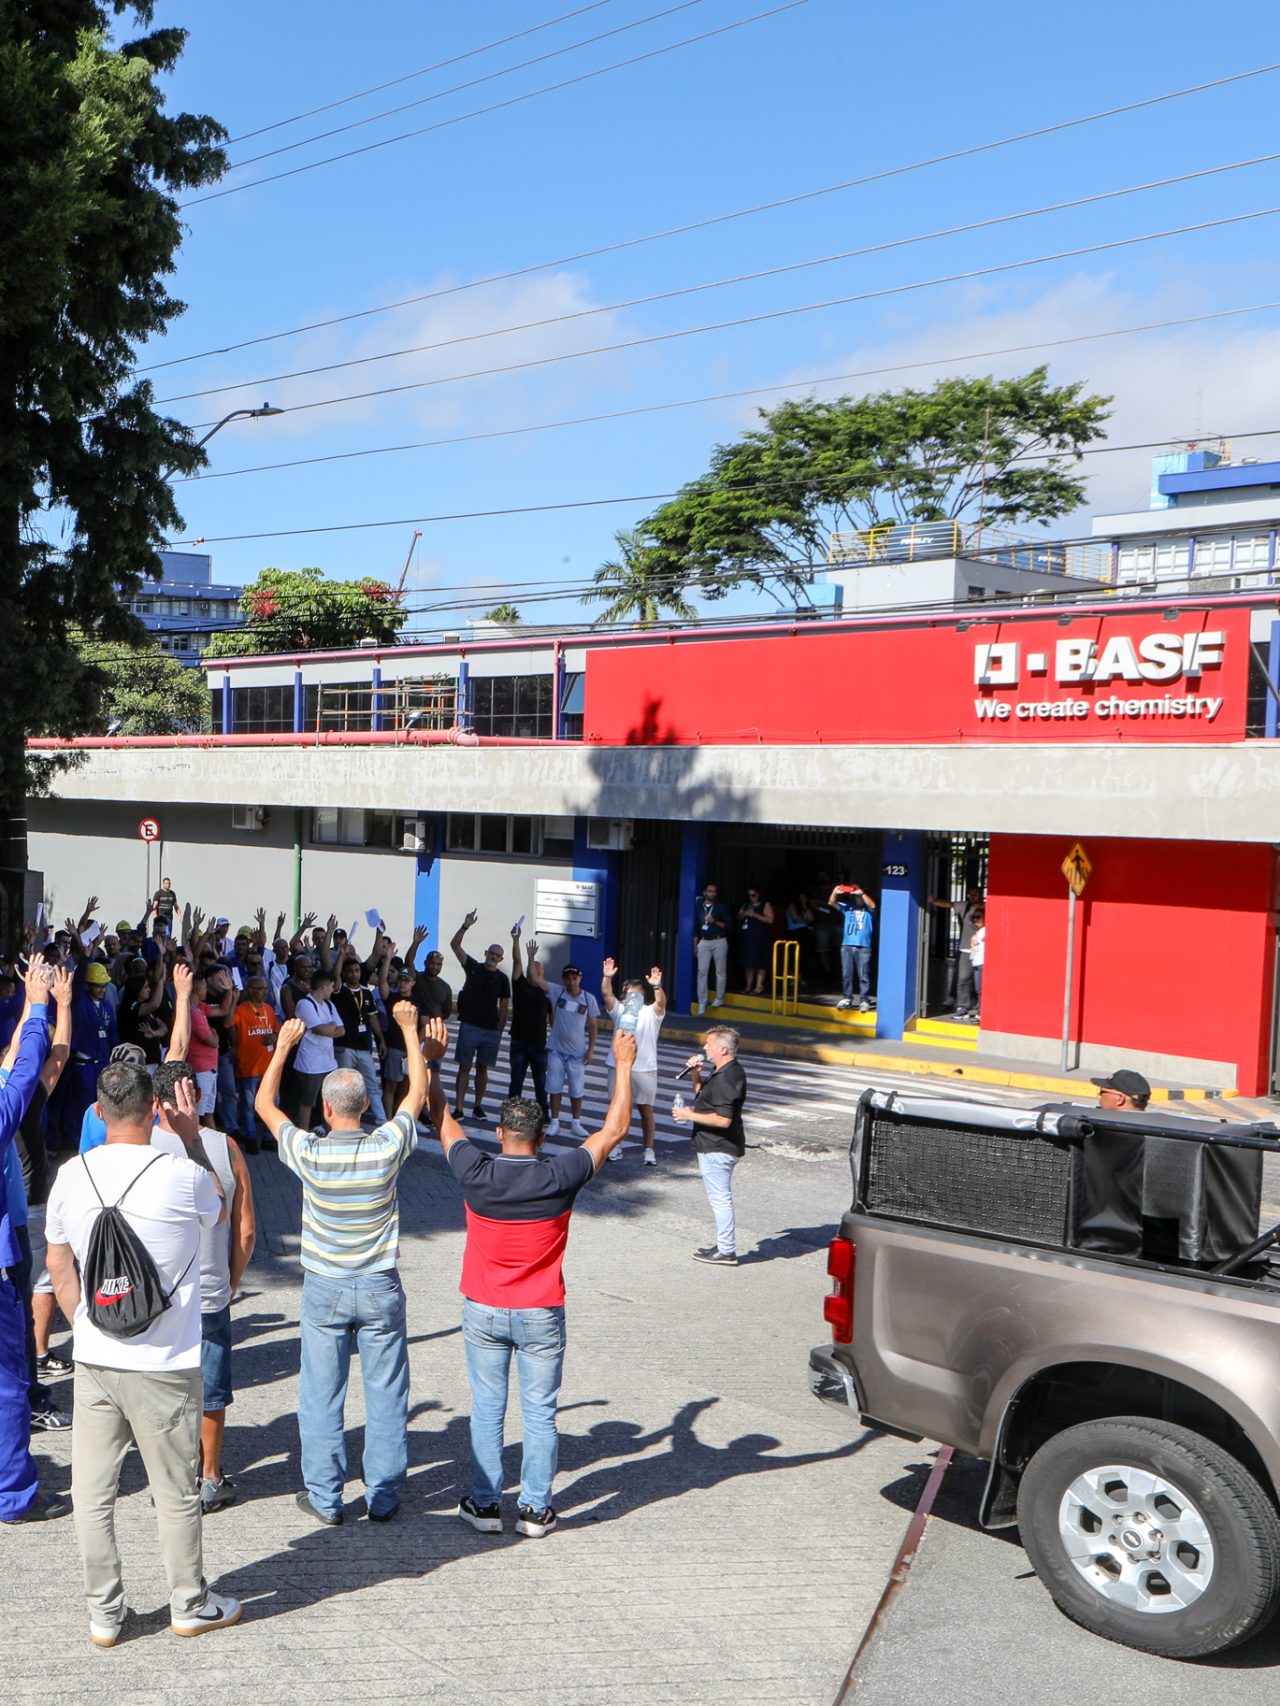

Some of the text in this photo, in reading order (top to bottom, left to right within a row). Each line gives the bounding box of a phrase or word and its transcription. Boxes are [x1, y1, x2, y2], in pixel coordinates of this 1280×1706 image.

[1055, 631, 1225, 682] BASF
[974, 694, 1223, 719] We create chemistry
[886, 865, 905, 875] 123
